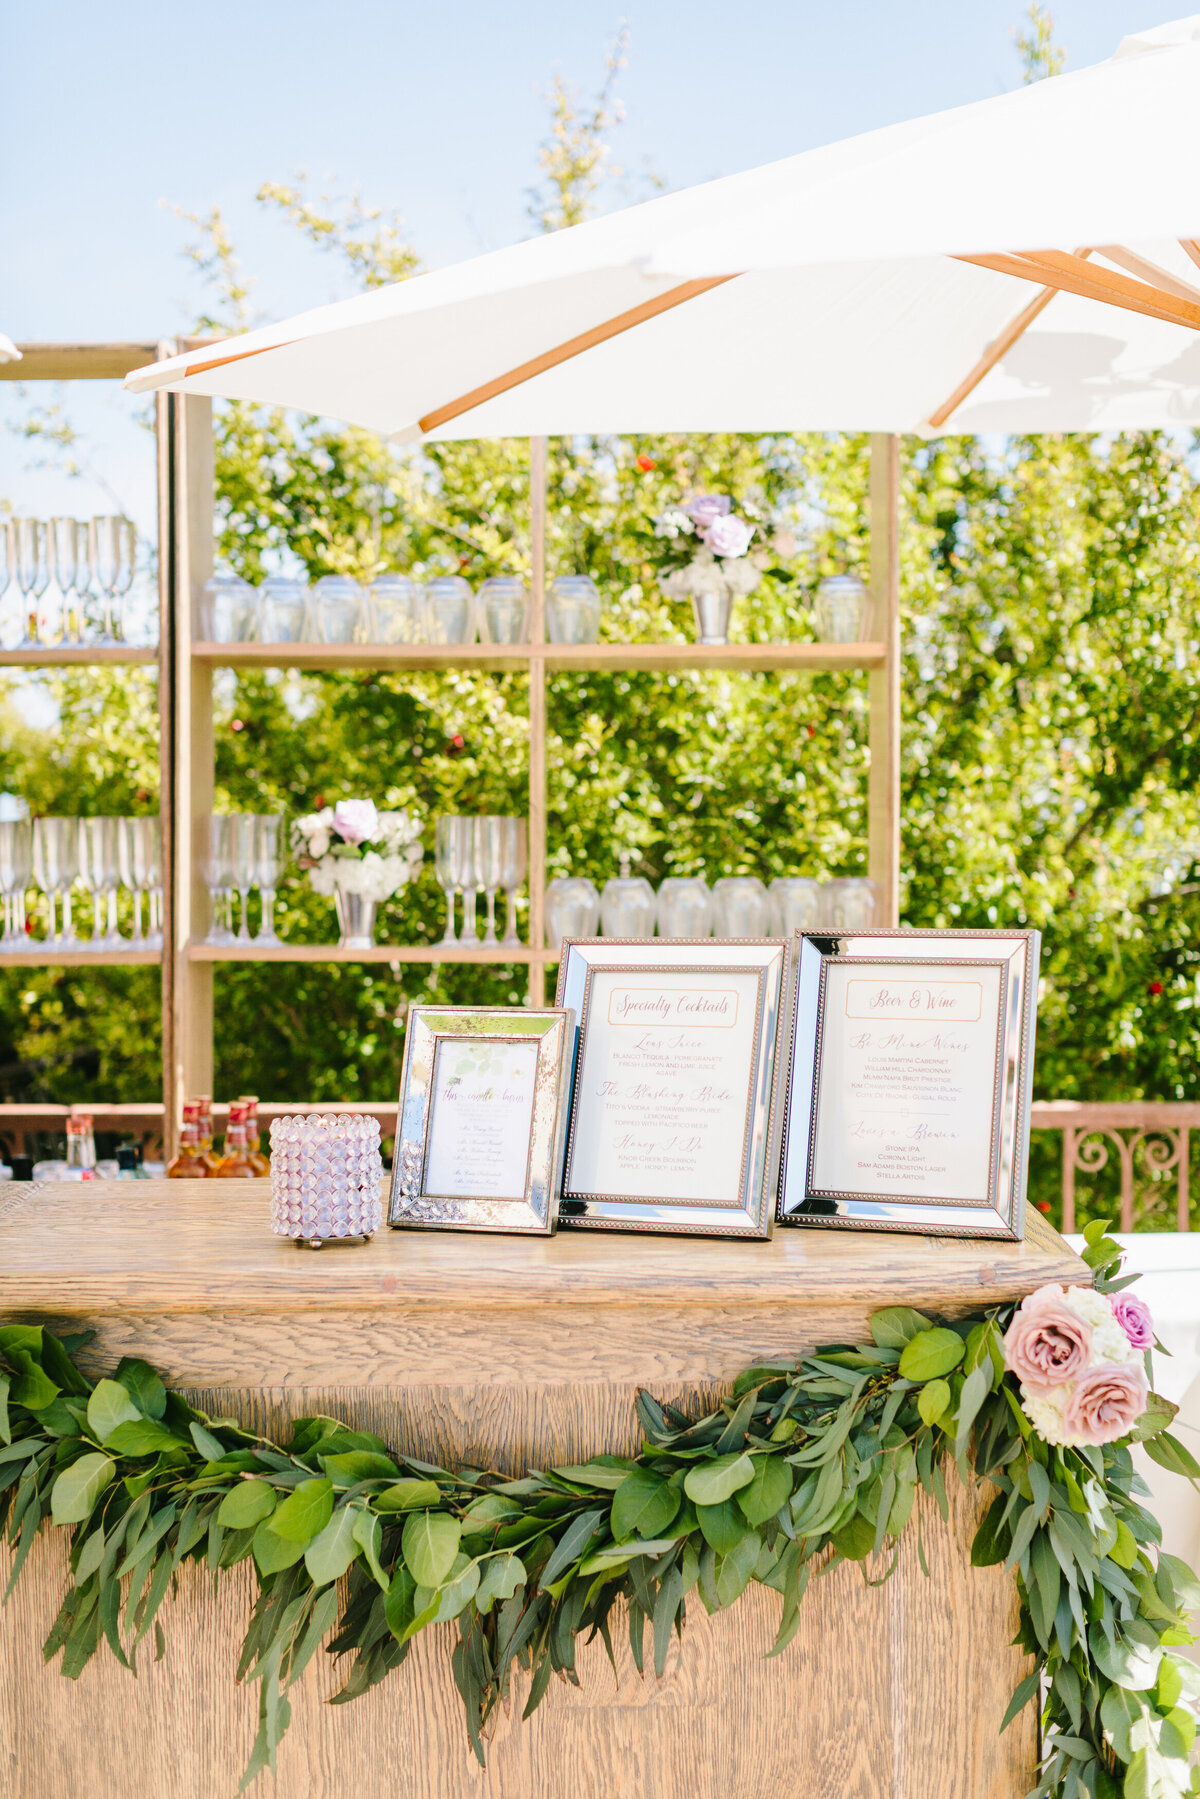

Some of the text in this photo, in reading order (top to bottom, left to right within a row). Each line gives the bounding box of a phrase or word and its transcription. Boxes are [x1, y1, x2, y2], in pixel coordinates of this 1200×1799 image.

[870, 989, 957, 1009] Beer & Wine
[616, 994, 729, 1019] Specialty Cocktails
[907, 1066, 952, 1074] CHARDONNAY
[596, 1081, 621, 1096] The
[873, 1162, 895, 1170] ADAMS
[902, 1173, 925, 1181] ARTOIS
